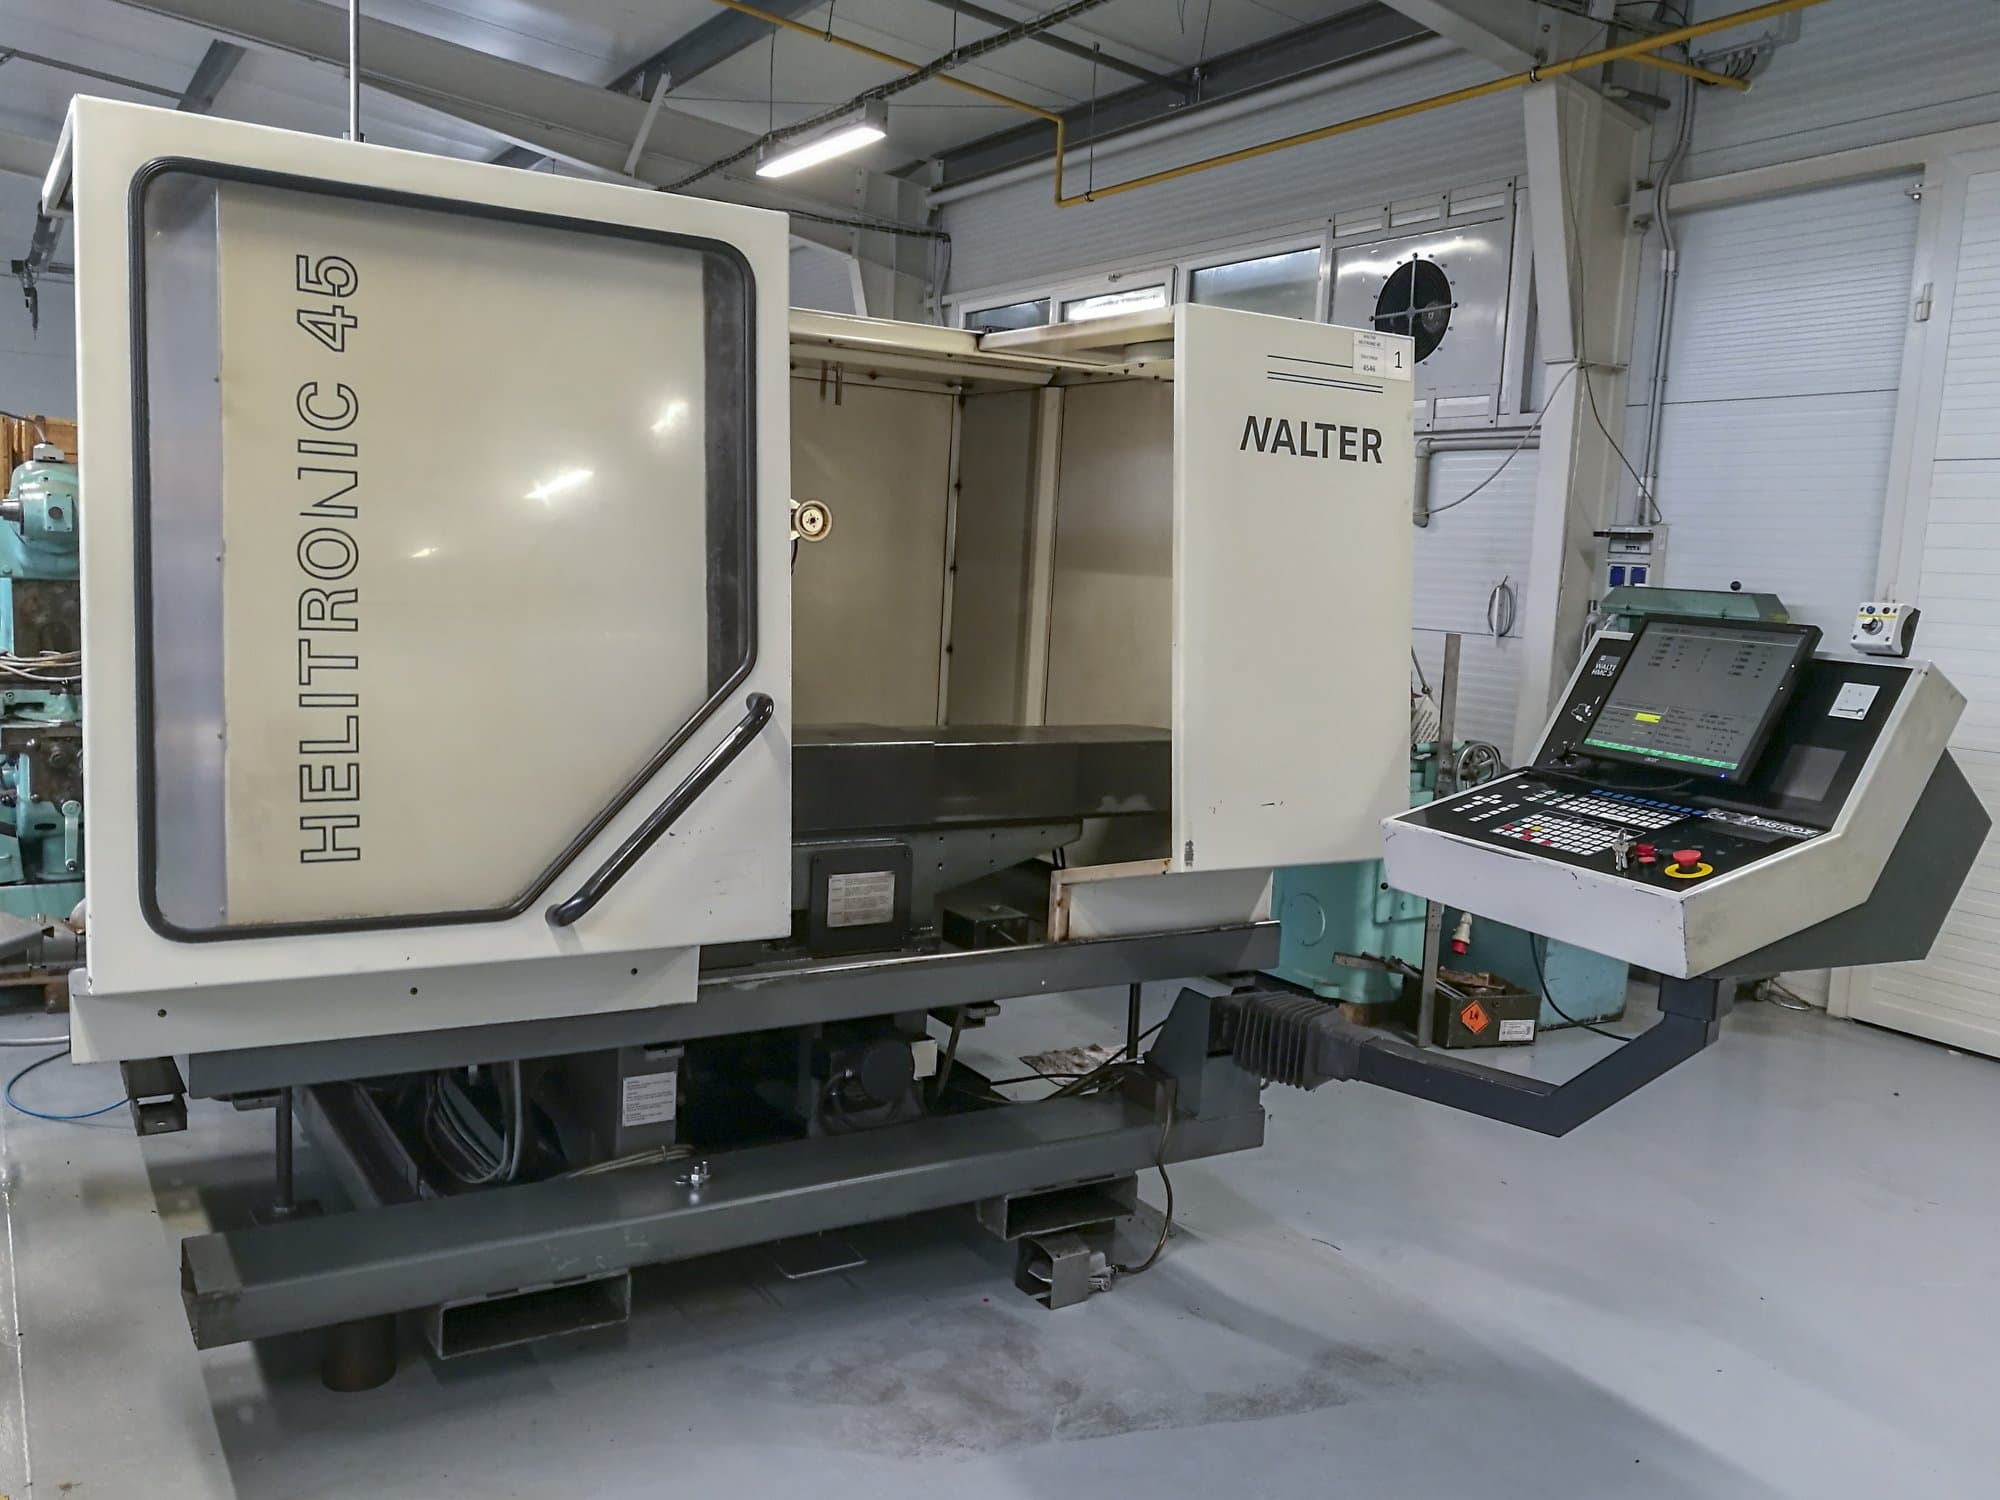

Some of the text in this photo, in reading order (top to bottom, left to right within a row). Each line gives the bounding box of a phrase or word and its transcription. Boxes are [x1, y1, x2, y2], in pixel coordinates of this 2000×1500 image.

[1394, 350, 1403, 369] 1
[296, 254, 362, 864] HELITRONIC 45
